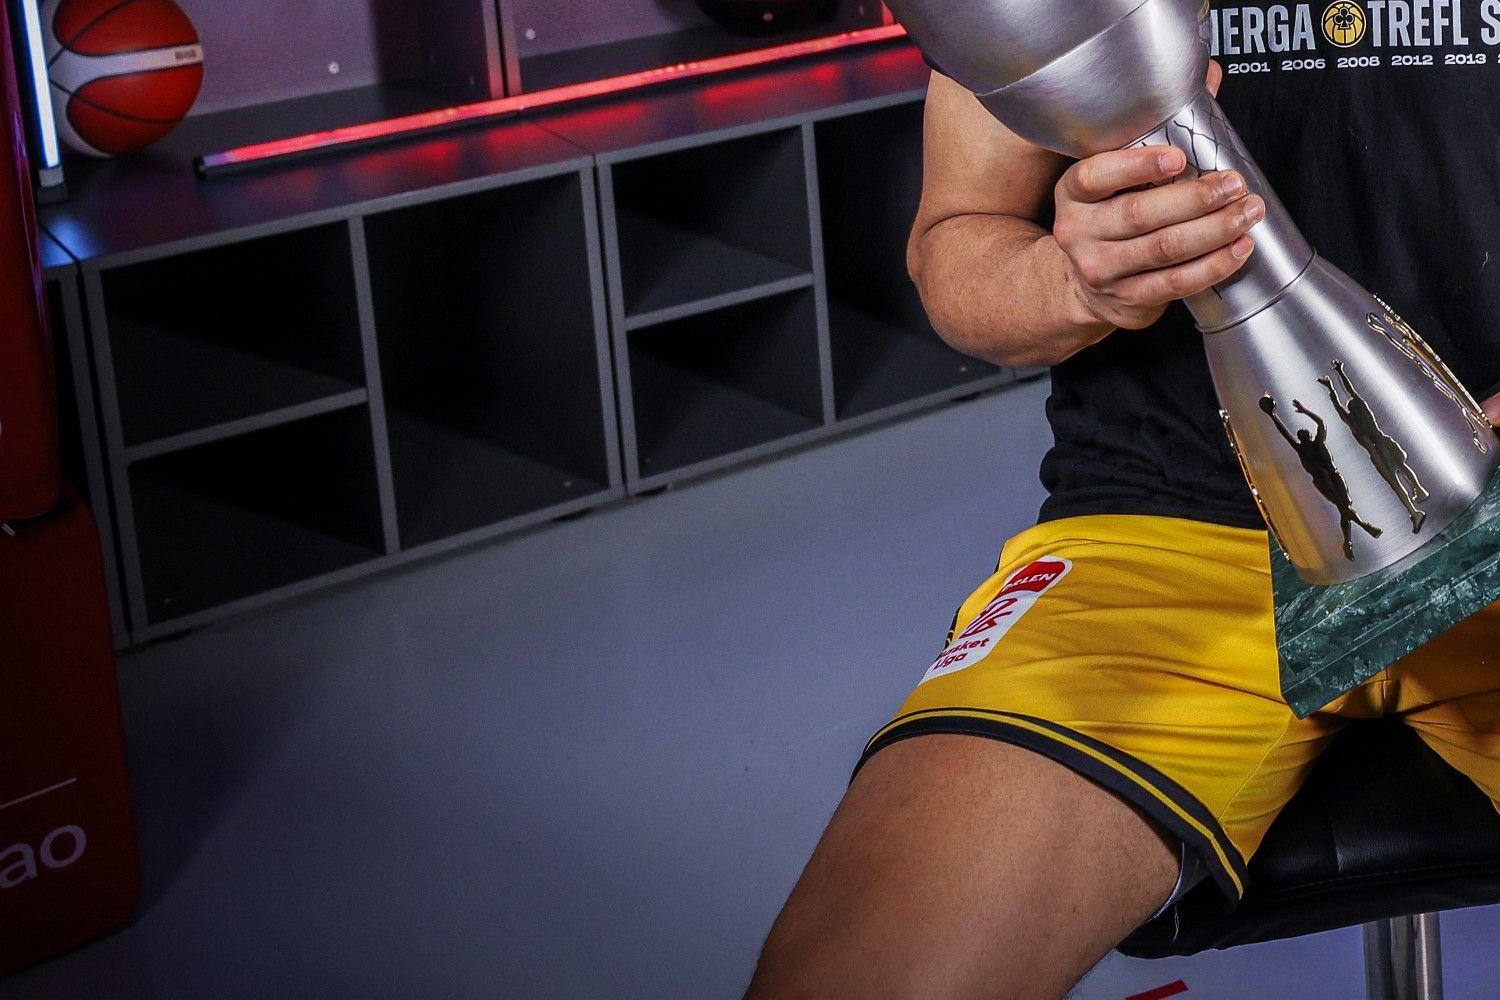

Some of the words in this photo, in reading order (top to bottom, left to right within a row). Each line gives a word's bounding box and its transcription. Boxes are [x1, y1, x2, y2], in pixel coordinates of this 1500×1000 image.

[1210, 4, 1316, 56] ERGA
[1367, 0, 1469, 47] TREFL
[1228, 62, 1271, 74] 2001
[1281, 58, 1326, 71] 2006
[1336, 56, 1380, 68] 2008
[1391, 55, 1434, 67] 2012
[1444, 53, 1487, 66] 2013
